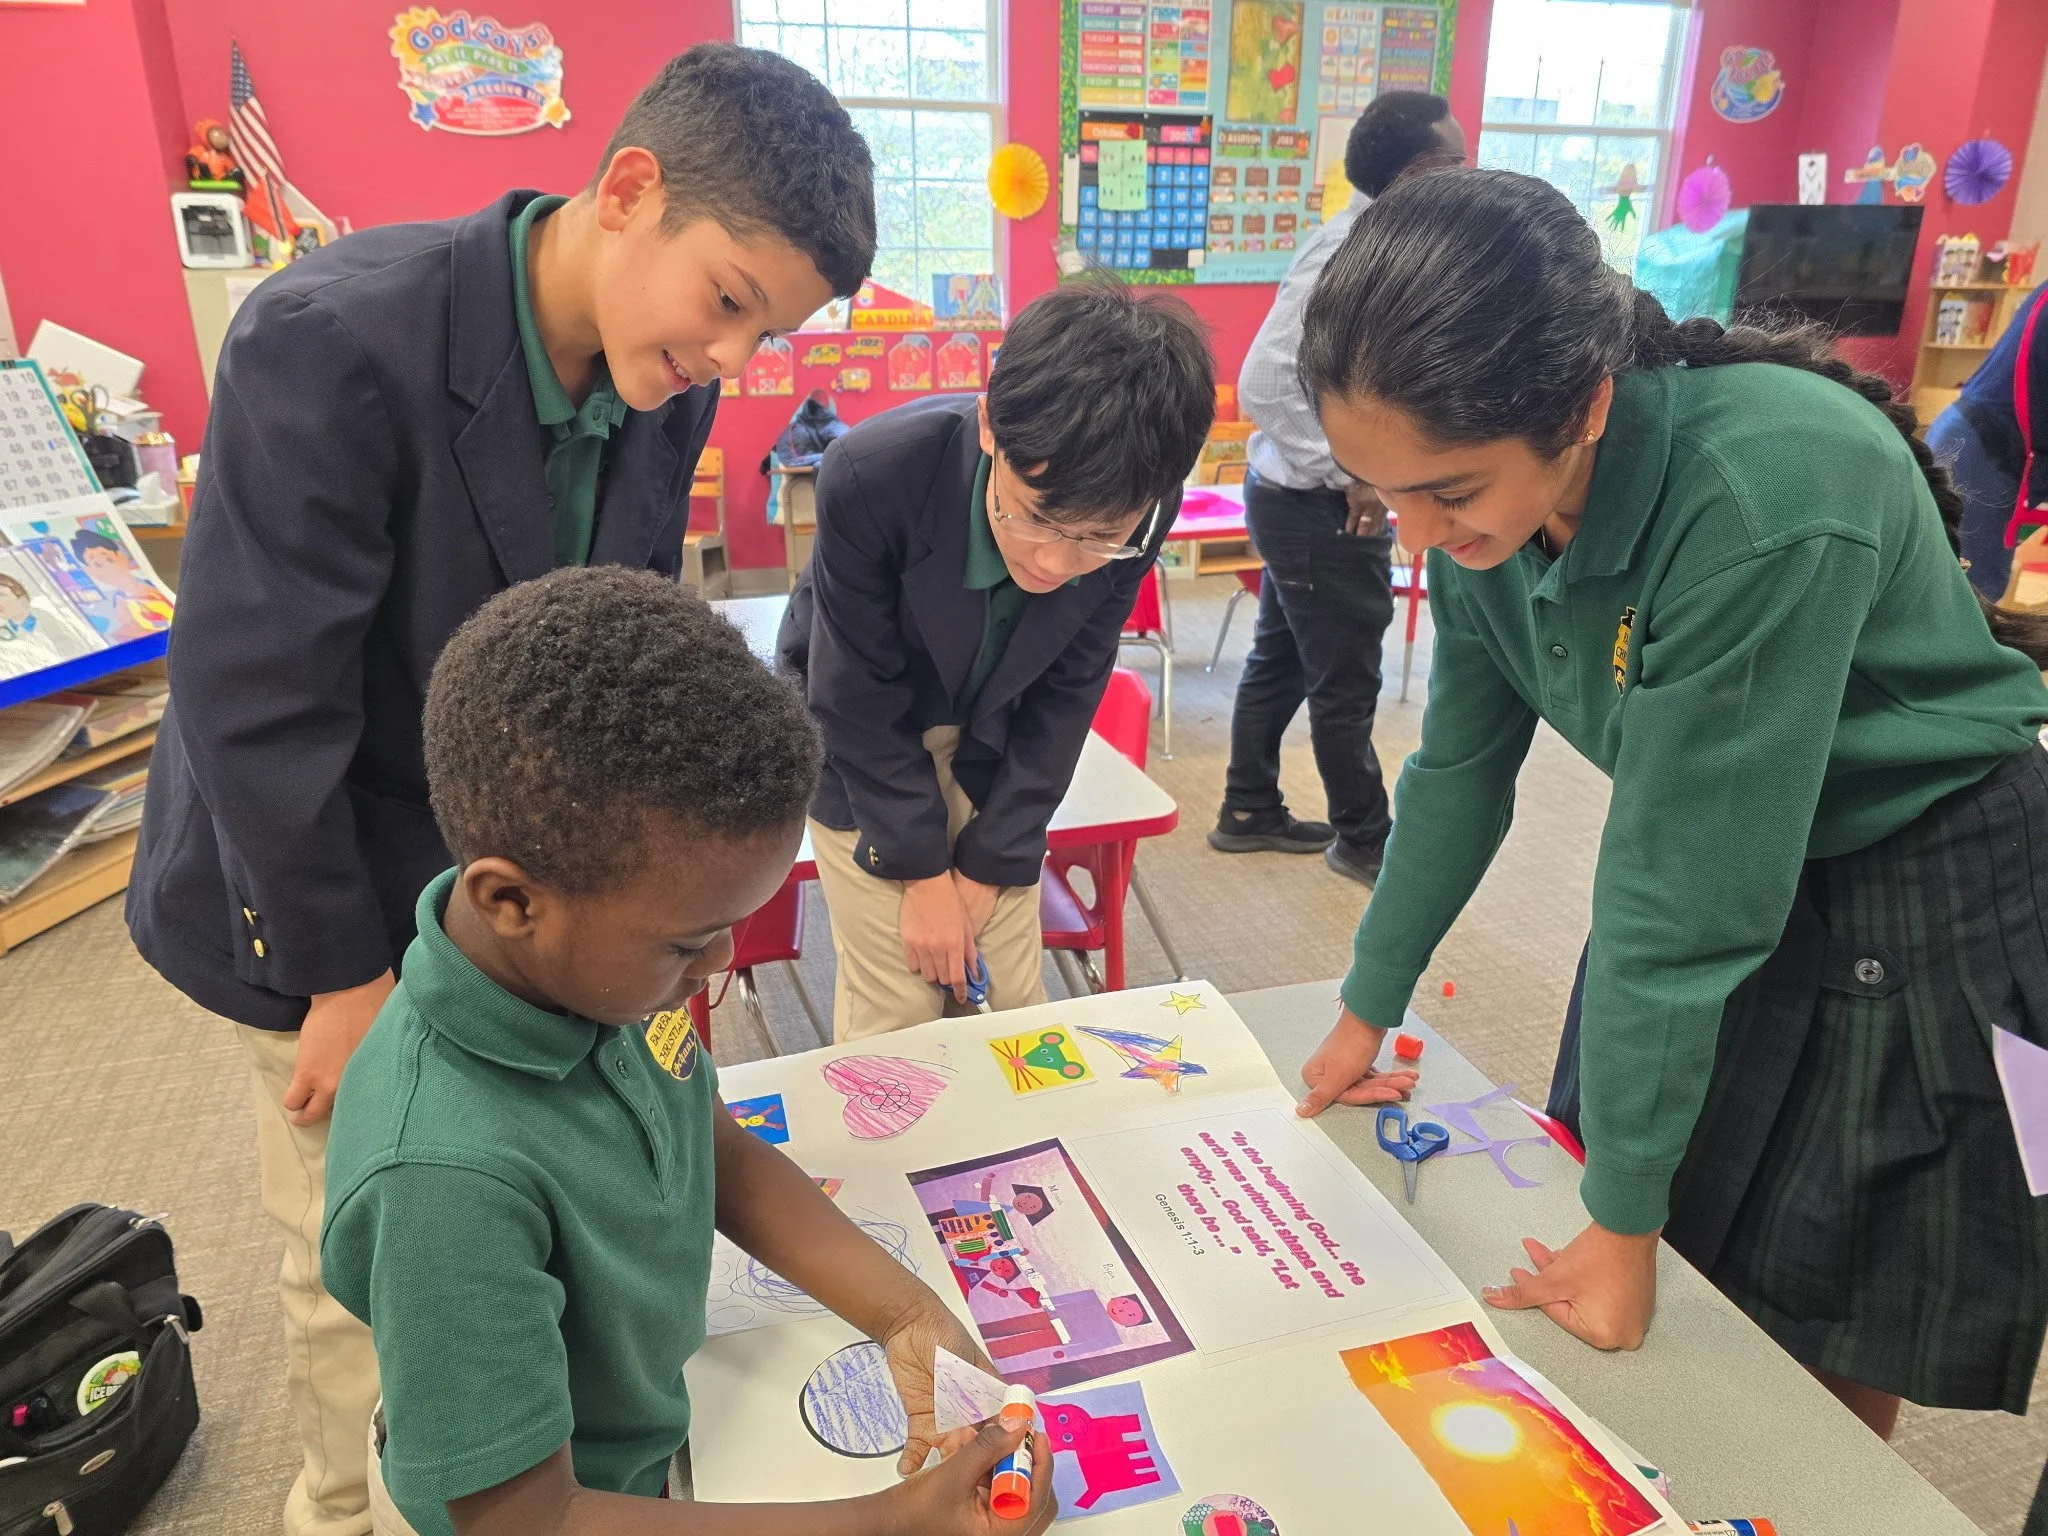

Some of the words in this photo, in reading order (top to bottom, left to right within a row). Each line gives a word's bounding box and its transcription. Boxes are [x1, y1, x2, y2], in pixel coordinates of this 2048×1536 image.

[1325, 9, 1374, 21] WEATHER
[411, 17, 466, 50] God
[479, 22, 539, 54] Says
[20, 372, 36, 385] 10
[5, 390, 20, 403] 19
[28, 388, 44, 401] 20
[13, 407, 29, 419] 29
[36, 404, 52, 417] 30
[46, 420, 60, 432] 40
[69, 469, 84, 480] 70
[4, 479, 18, 492] 67
[12, 495, 27, 507] 77
[650, 1012, 675, 1046] FAIRFA
[659, 1011, 690, 1065] CHRISTIAN
[673, 1036, 695, 1077] School
[1176, 1183, 1208, 1216] there
[1200, 1215, 1221, 1234] be
[1180, 1146, 1216, 1185] empty,
[1222, 1198, 1253, 1227] God
[1241, 1225, 1276, 1258] said,
[1198, 1131, 1229, 1158] earth
[1222, 1157, 1247, 1184] was
[1240, 1182, 1286, 1229] without
[1275, 1226, 1317, 1271] shape
[1310, 1269, 1345, 1299] and
[1242, 1146, 1265, 1165] the
[1257, 1165, 1315, 1223] beginning
[1306, 1222, 1341, 1261] God...
[1339, 1261, 1365, 1286] the
[1155, 1193, 1185, 1231] Genesis
[1180, 1231, 1205, 1256] 1:1-3
[89, 1386, 106, 1402] ICE
